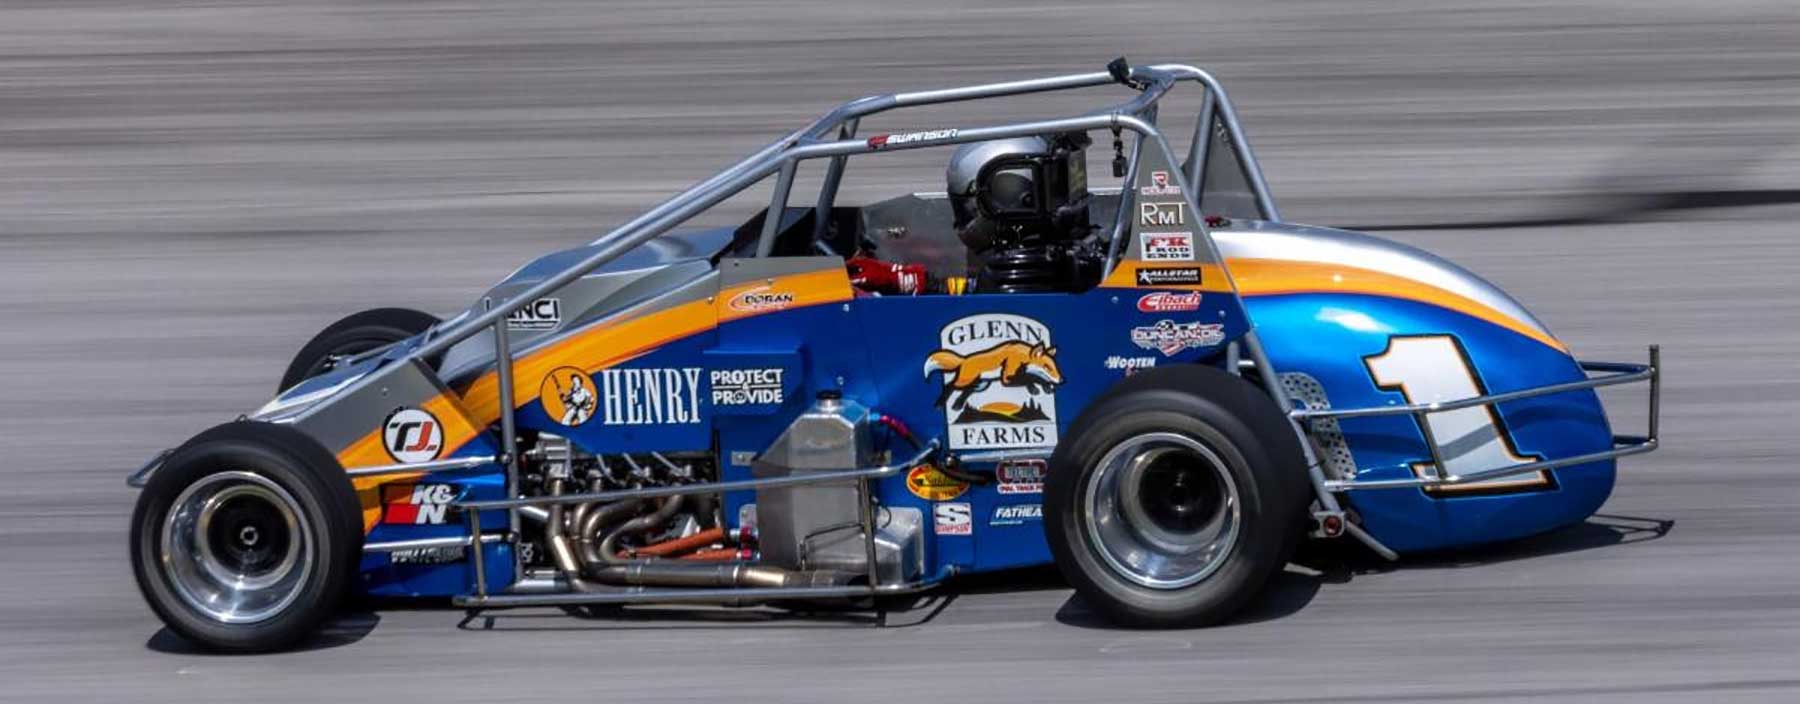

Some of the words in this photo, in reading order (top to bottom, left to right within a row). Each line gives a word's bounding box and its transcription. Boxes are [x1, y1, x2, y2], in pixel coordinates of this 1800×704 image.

[1141, 202, 1187, 225] RMT
[745, 294, 793, 304] DORAN
[948, 320, 1043, 346] GLENN
[1133, 328, 1195, 340] DUNCAN
[711, 368, 784, 385] PROTECT
[601, 367, 704, 425] HENRY
[712, 388, 784, 406] PROVIDE
[1360, 333, 1562, 501] 1
[962, 426, 1046, 446] FARMS
[416, 504, 448, 525] N
[996, 506, 1043, 518] FATHEA
